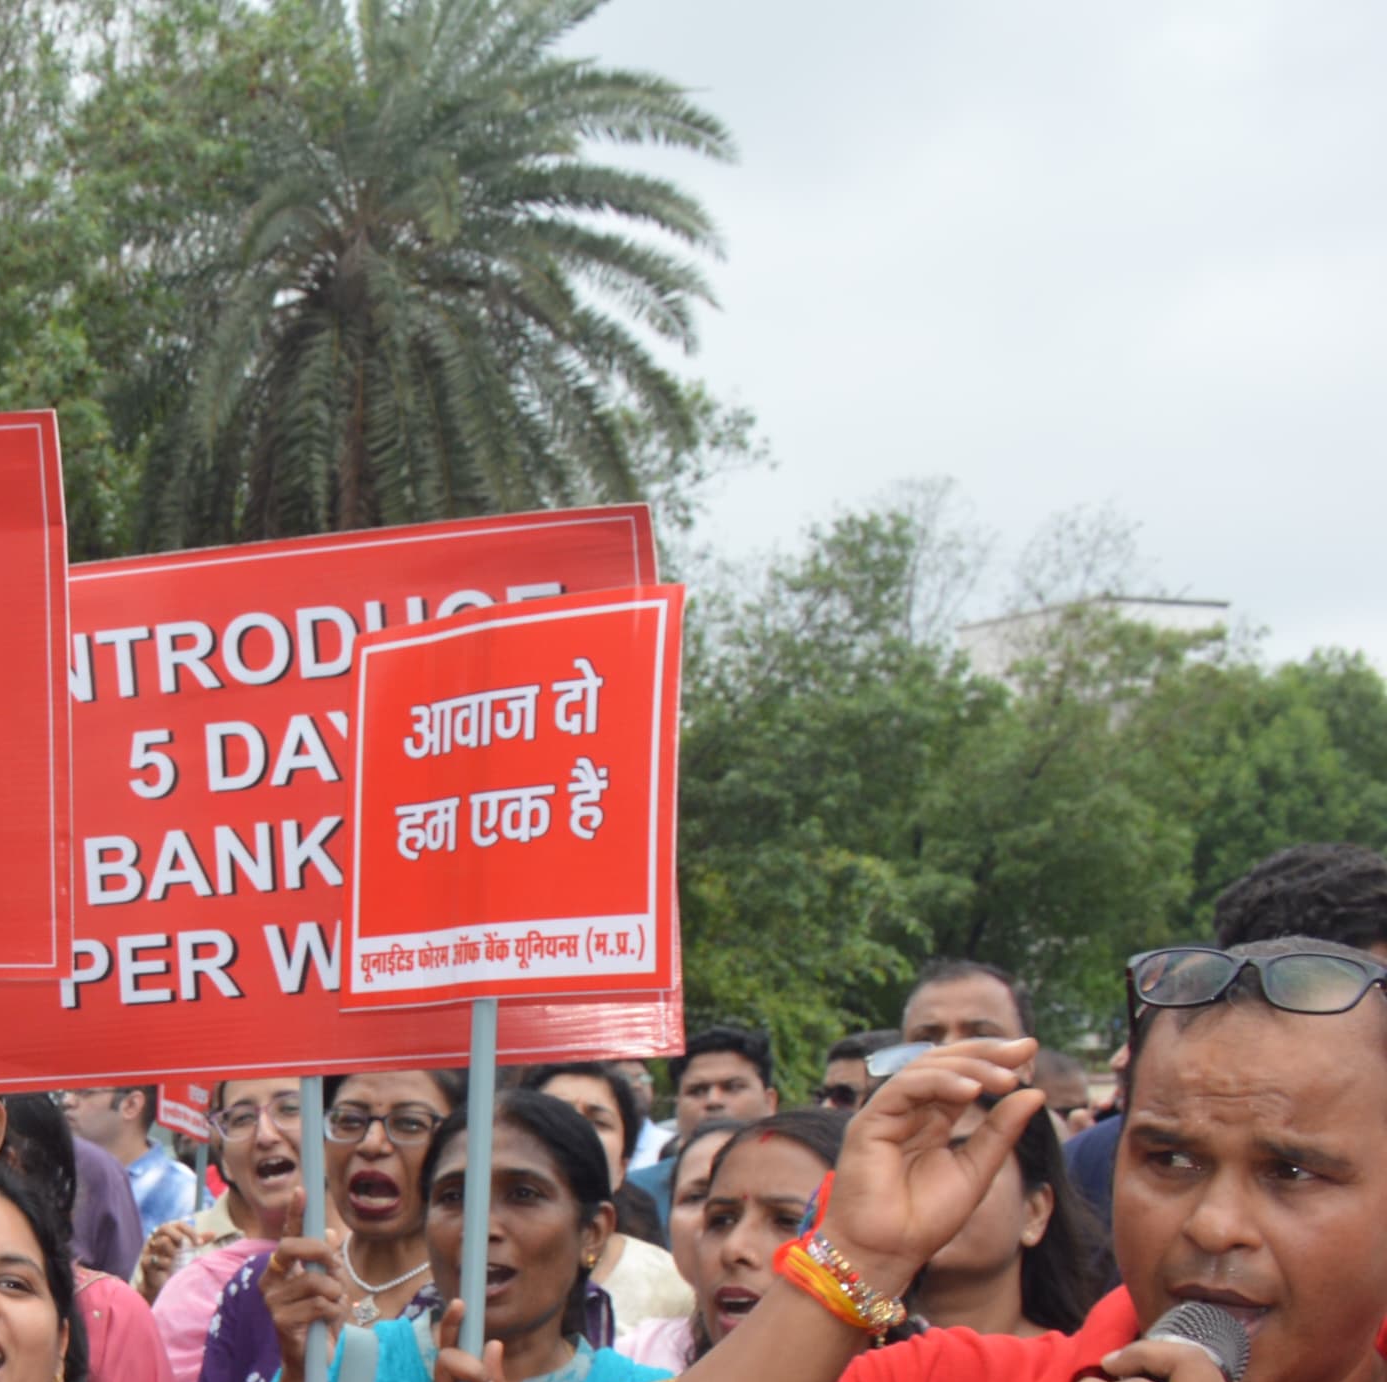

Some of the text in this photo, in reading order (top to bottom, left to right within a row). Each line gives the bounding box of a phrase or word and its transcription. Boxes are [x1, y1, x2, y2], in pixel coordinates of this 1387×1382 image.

[70, 583, 565, 702] NTROD
[403, 658, 604, 759] आवाज दो
[129, 710, 348, 799] 5 DA
[395, 757, 609, 861] हम एक हैं
[83, 815, 343, 906] BANK
[61, 928, 247, 1008] PER
[483, 931, 511, 963] बैंक
